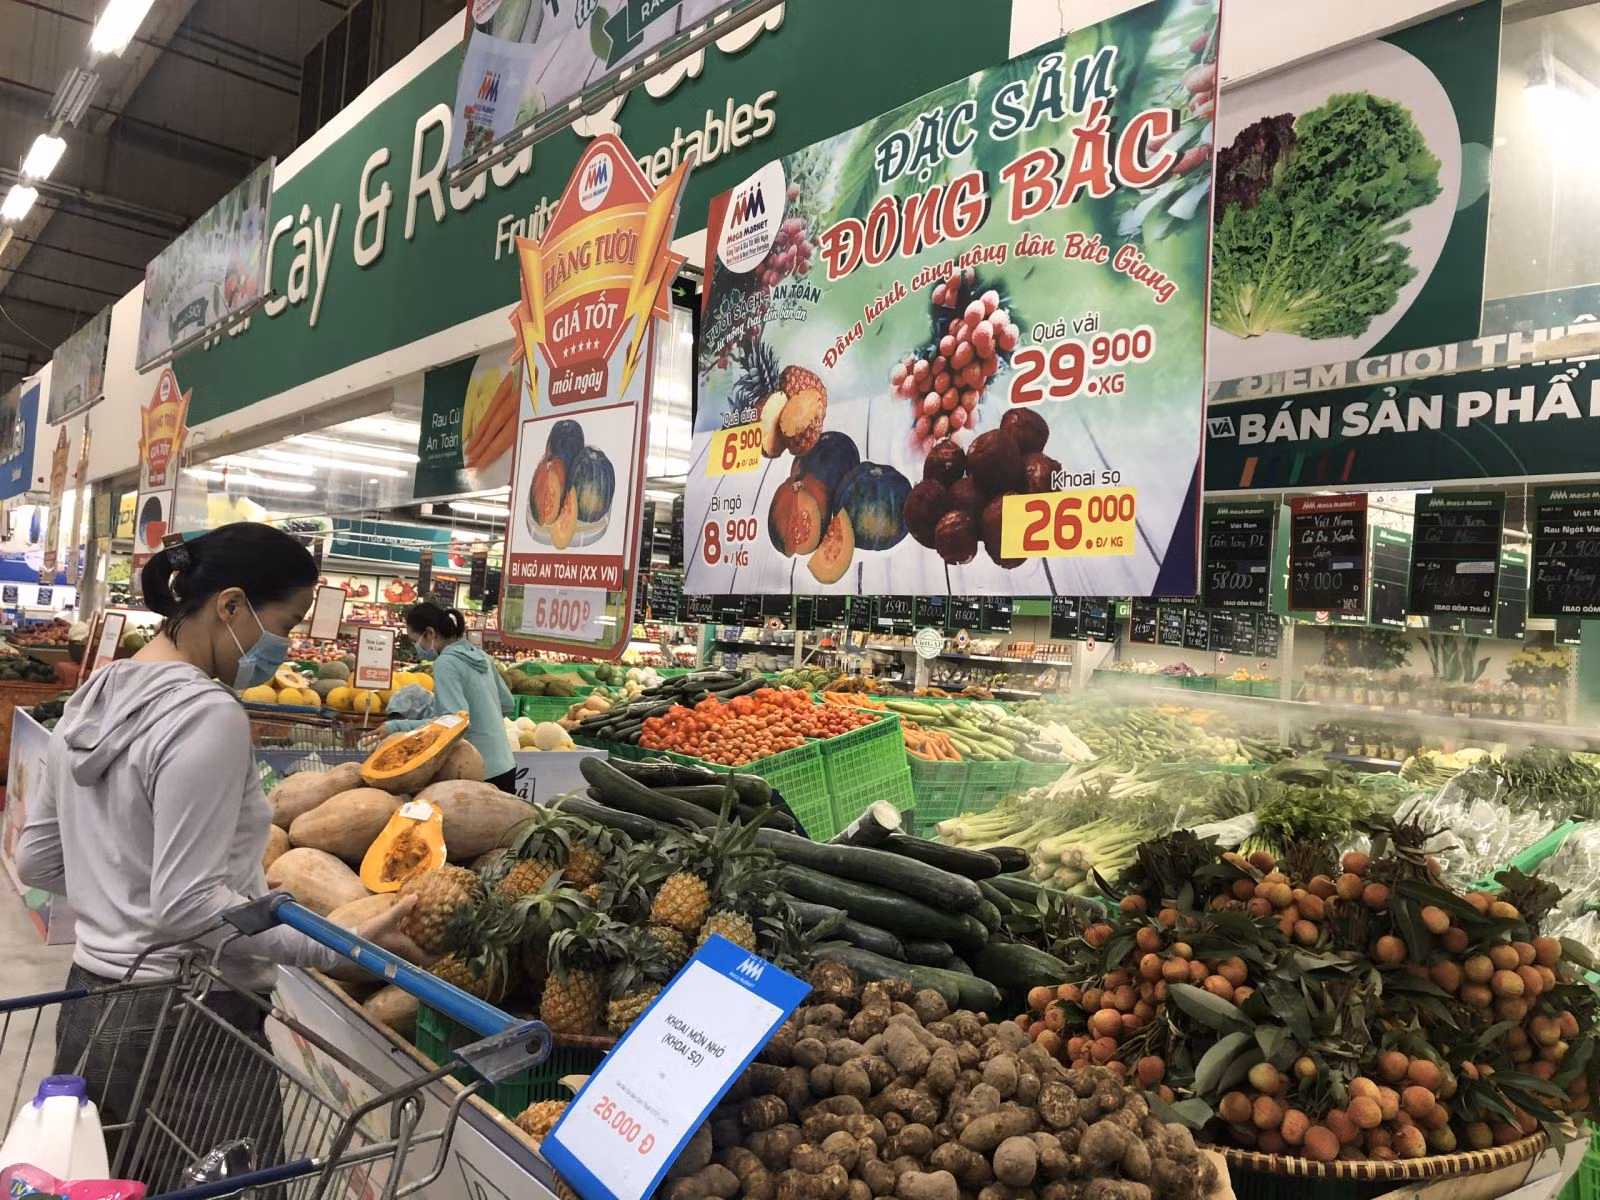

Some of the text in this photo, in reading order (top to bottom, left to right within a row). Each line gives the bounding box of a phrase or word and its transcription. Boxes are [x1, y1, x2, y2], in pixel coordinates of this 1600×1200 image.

[876, 46, 1118, 184] ĐẶC SẢN
[636, 90, 778, 187] getables
[820, 97, 1184, 282] ĐÔNG BẮC
[264, 203, 342, 328] Cây
[353, 147, 394, 269] &
[544, 240, 592, 298] HÀNG
[773, 286, 788, 300] AN
[790, 282, 822, 304] TOÀN
[822, 232, 1178, 370] Đồng hành cùng nông dân Bắc Giang
[552, 290, 619, 343] GIÁ TỐT
[1033, 312, 1100, 342] Quả vải
[551, 368, 604, 395] mỗi ngày
[432, 412, 448, 429] Rau
[1211, 361, 1600, 446] VÀ BÁN SẢN PHẨ
[425, 436, 438, 452] An
[1052, 470, 1121, 488] Khoai sọ
[539, 563, 552, 578] AN
[553, 561, 578, 579] TOÀN
[579, 564, 598, 584] (XX
[600, 565, 618, 585] VN)
[664, 1013, 690, 1035] KHOAI
[660, 1032, 690, 1056] (KHOAI
[593, 1096, 642, 1143] 26.000
